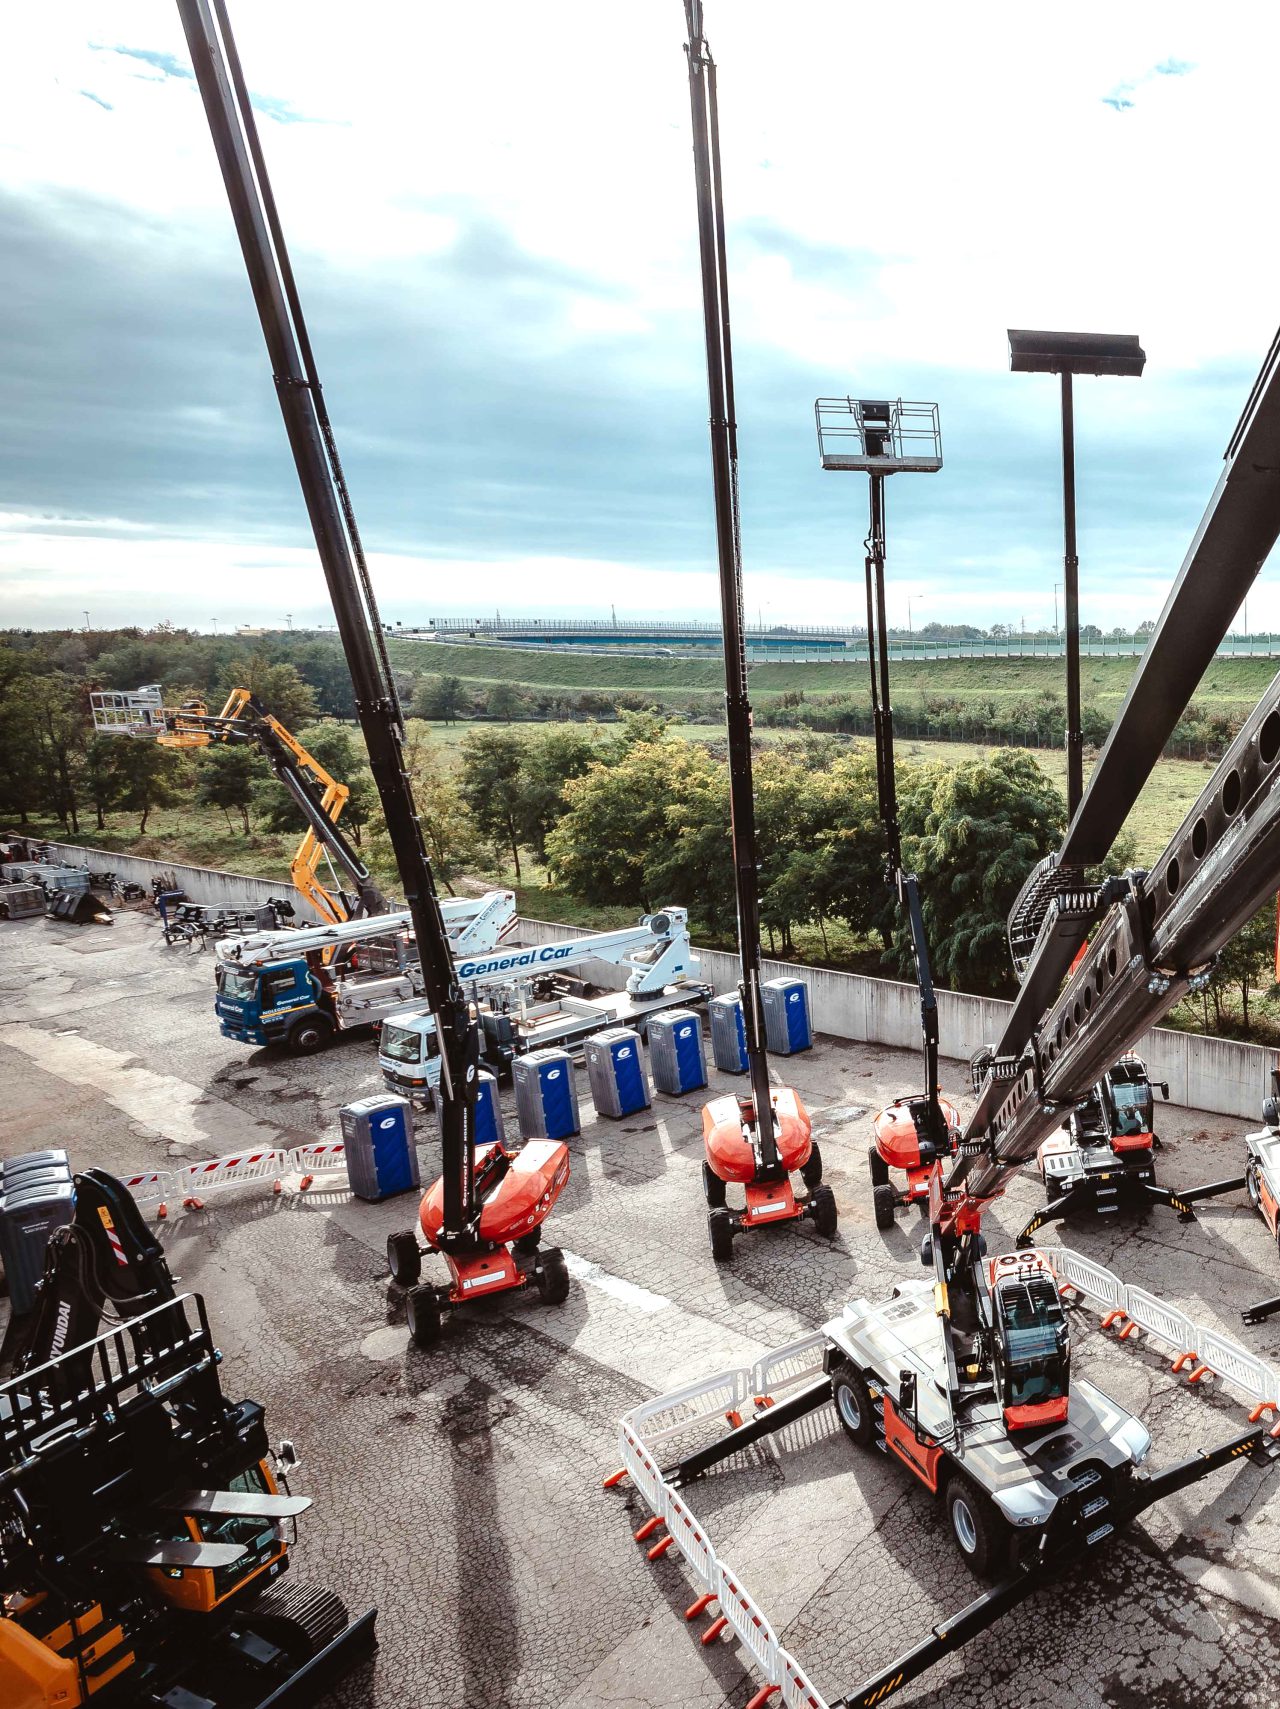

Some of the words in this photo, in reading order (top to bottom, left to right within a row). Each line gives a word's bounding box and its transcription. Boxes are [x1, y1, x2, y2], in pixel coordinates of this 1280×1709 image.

[458, 950, 537, 978] General
[539, 946, 573, 962] Car
[276, 995, 300, 1006] General
[262, 1005, 292, 1016] NOLEGGIO
